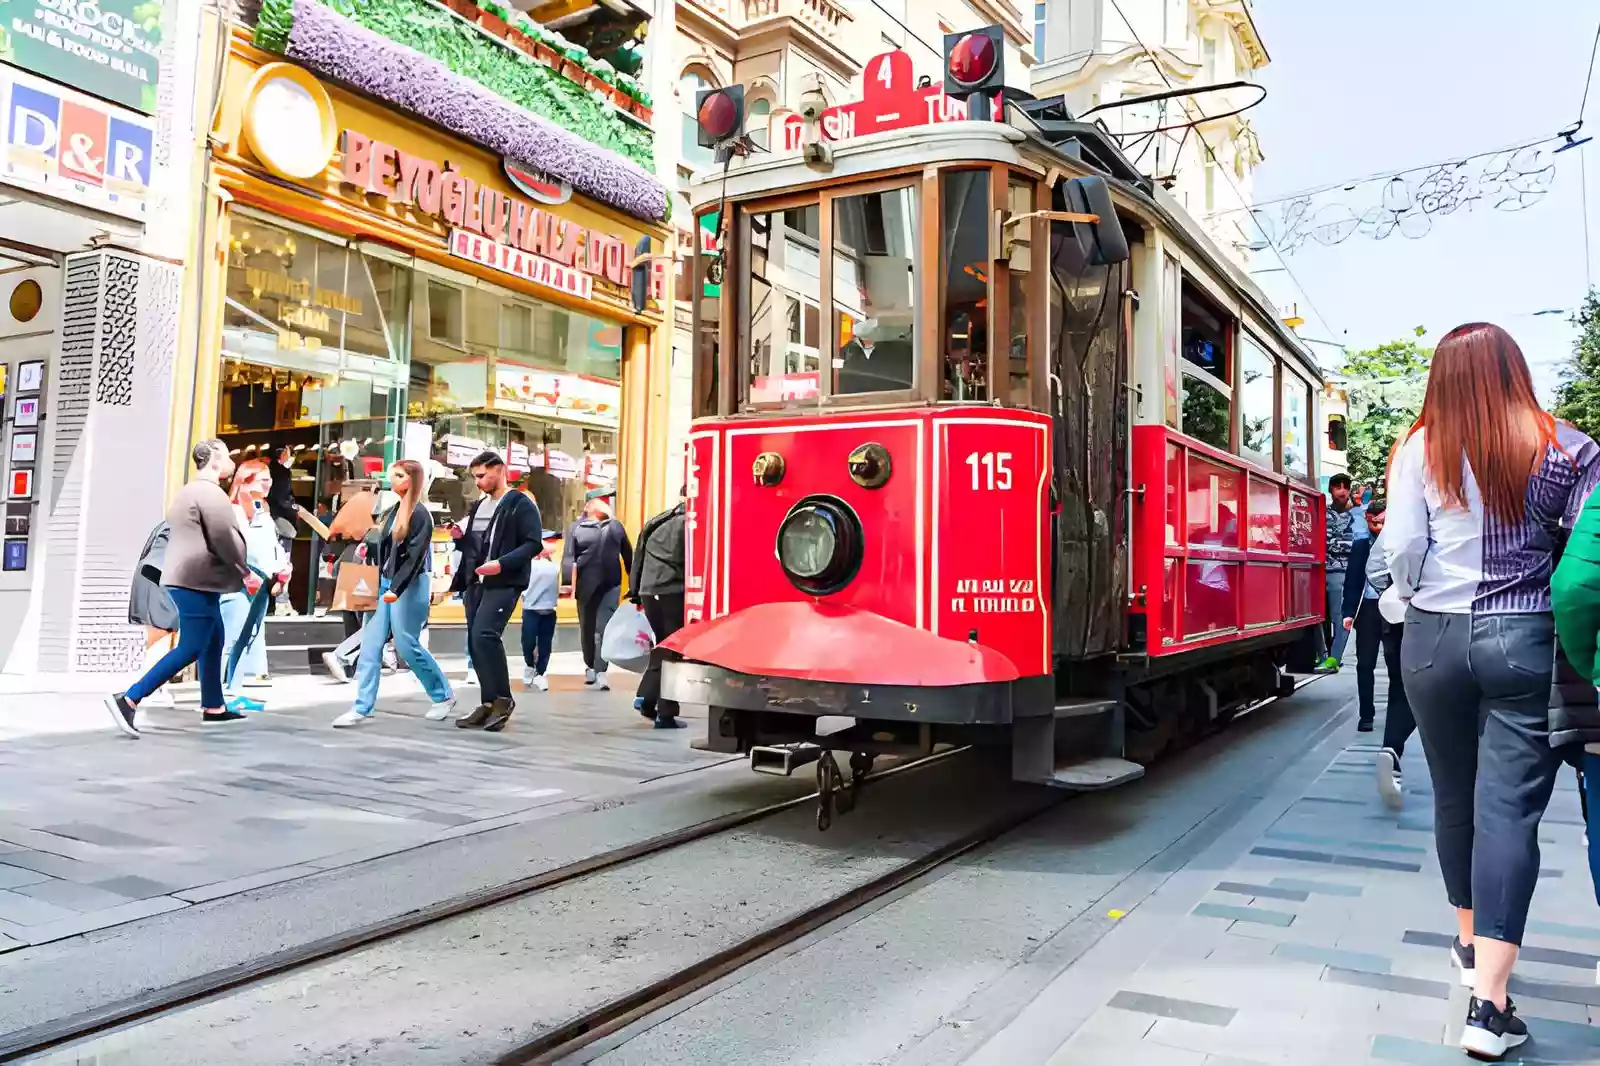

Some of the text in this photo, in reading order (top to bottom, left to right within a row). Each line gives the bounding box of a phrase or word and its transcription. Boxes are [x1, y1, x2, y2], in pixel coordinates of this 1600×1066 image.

[877, 56, 893, 89] 4
[13, 105, 144, 185] D&R
[965, 451, 1013, 491] 115
